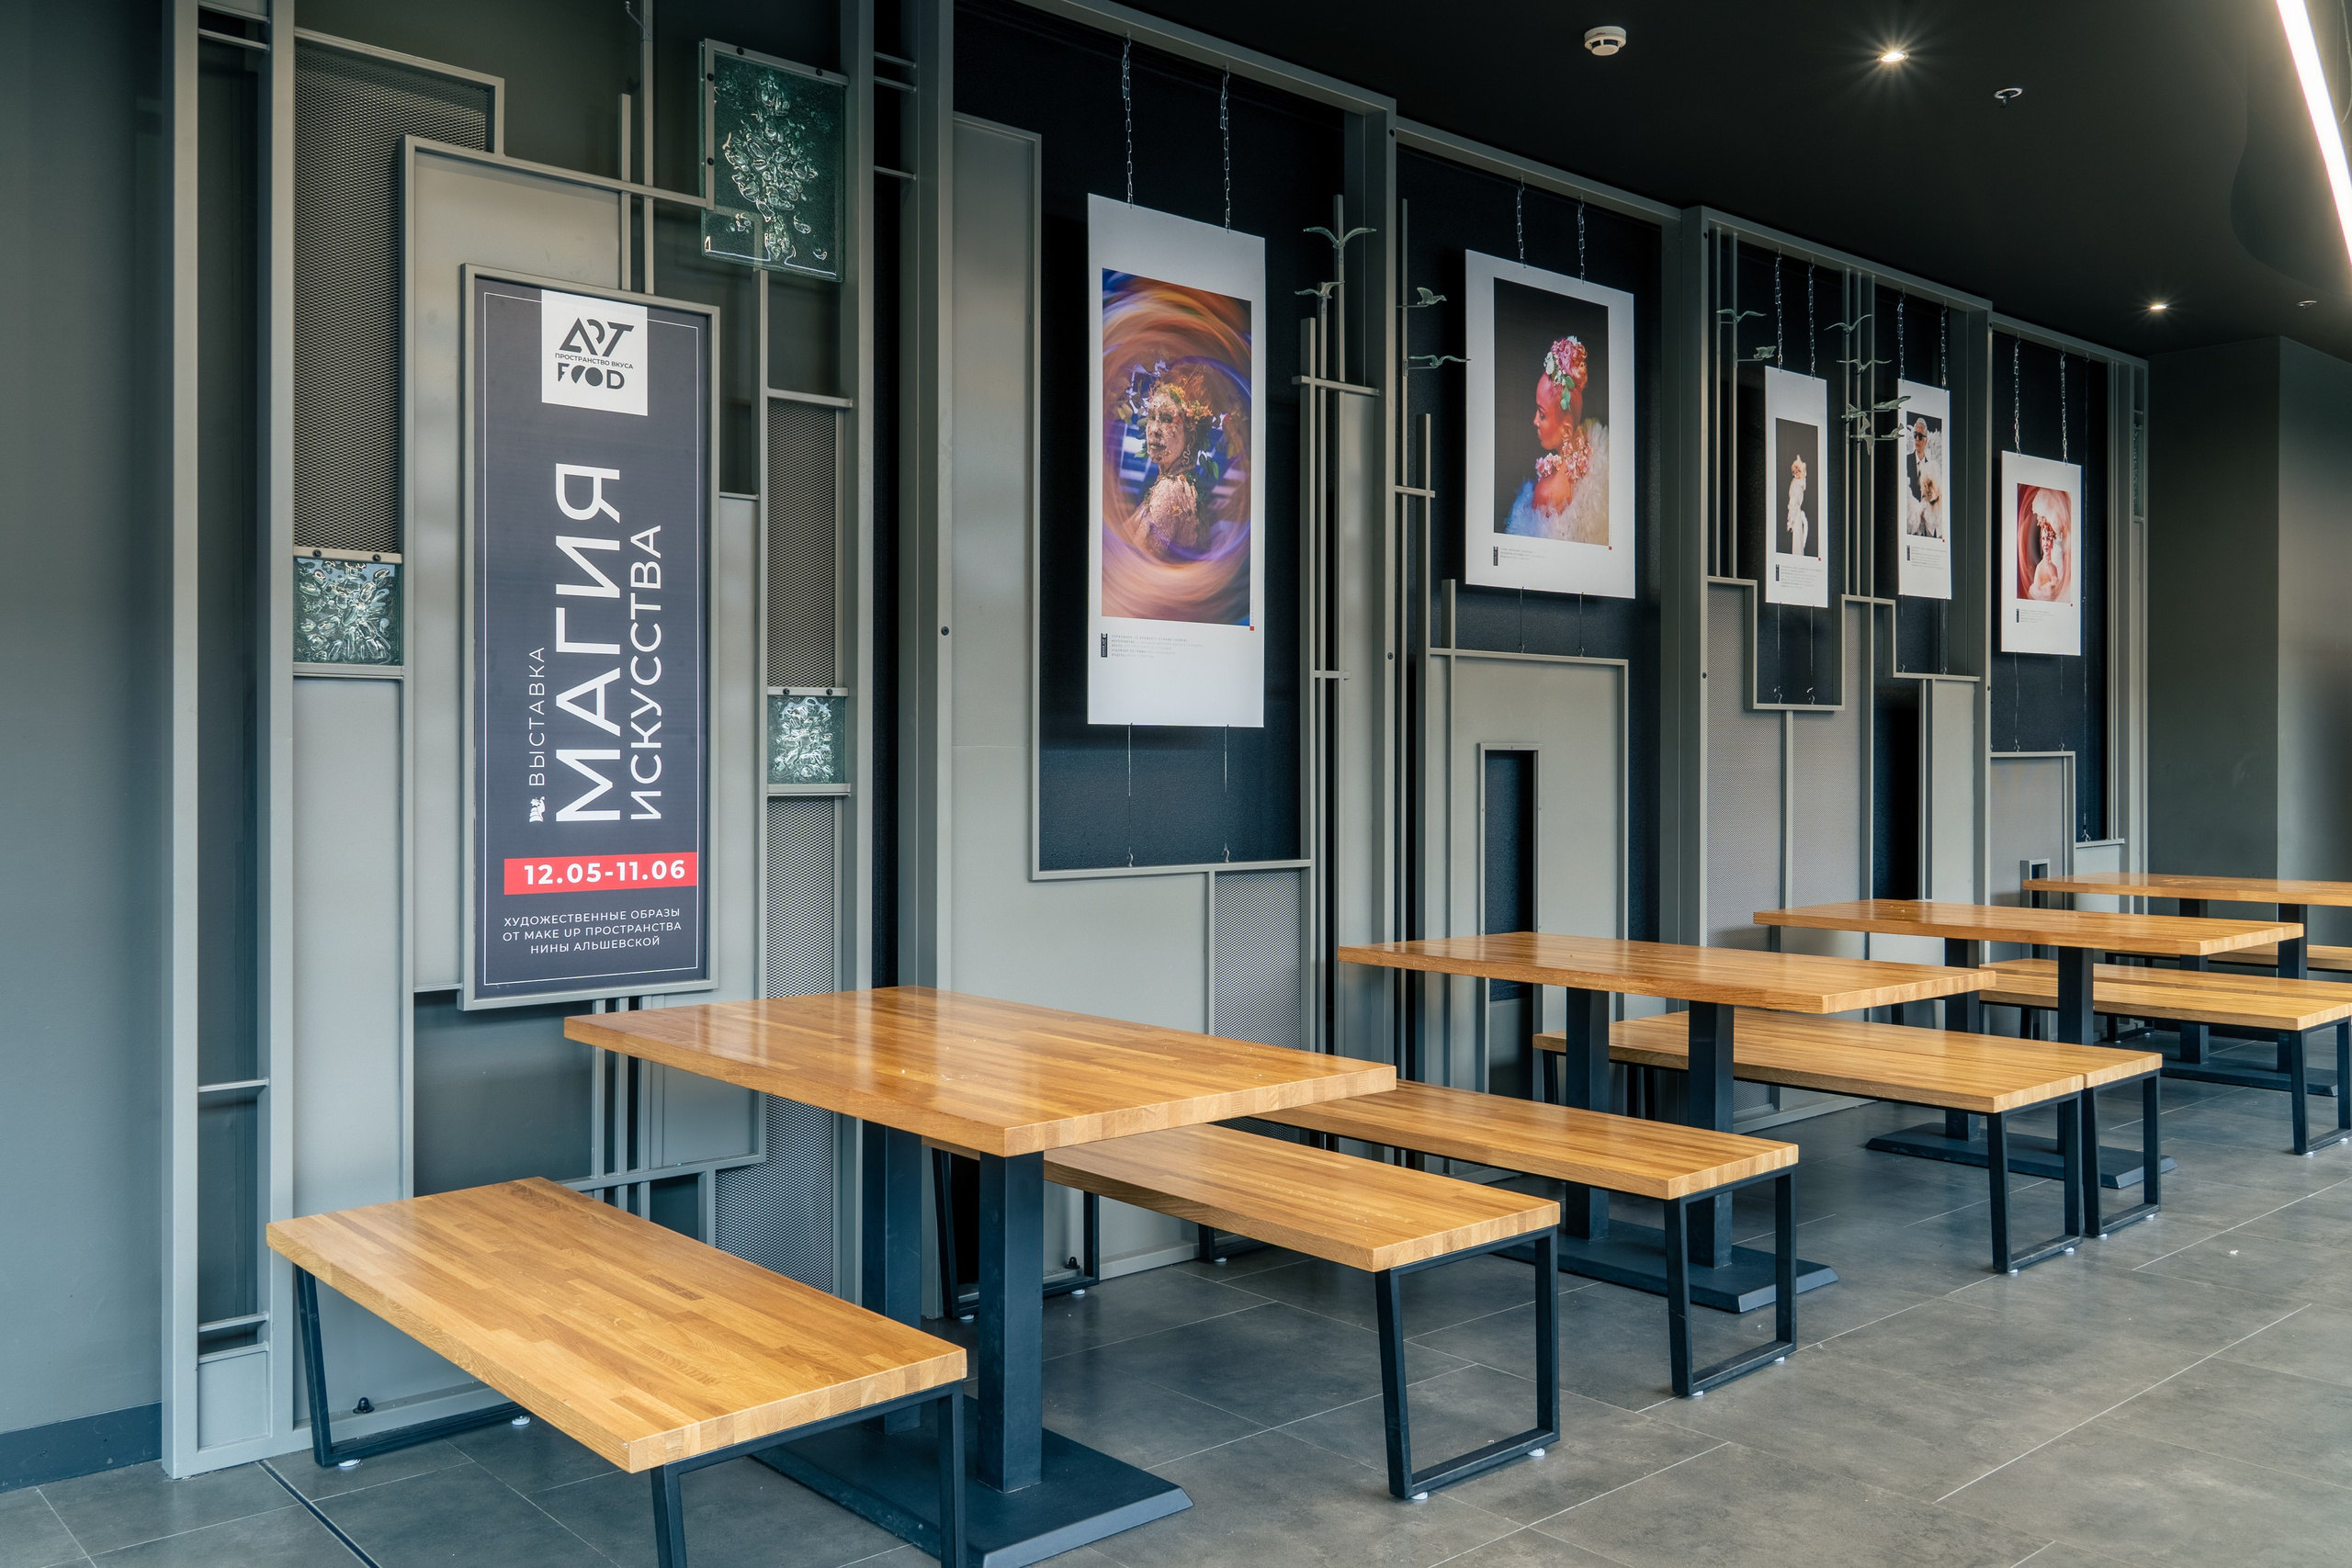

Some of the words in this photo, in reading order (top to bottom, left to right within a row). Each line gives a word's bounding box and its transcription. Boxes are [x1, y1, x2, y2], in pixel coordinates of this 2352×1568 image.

[560, 318, 634, 357] ART
[556, 354, 609, 366] ПРОСТРАНСТВО
[558, 363, 625, 389] FOOD
[556, 463, 620, 821] МАГИЯ
[630, 525, 662, 819] ИСКУССТВА
[529, 648, 545, 785] ВЫСТАВКА
[525, 860, 684, 885] 12.05-11.06
[504, 911, 626, 927] ХУДОЖЕСТВЕННЫЕ
[631, 908, 679, 919] ОБРАЗЫ
[503, 931, 519, 941] ОТ
[525, 930, 559, 940] MAKE
[565, 929, 581, 937] UP
[586, 922, 681, 936] ПРОСТРАНСТВА
[531, 943, 569, 953] НИНЫ
[574, 936, 659, 951] АЛЬШЕВСКОЙ
